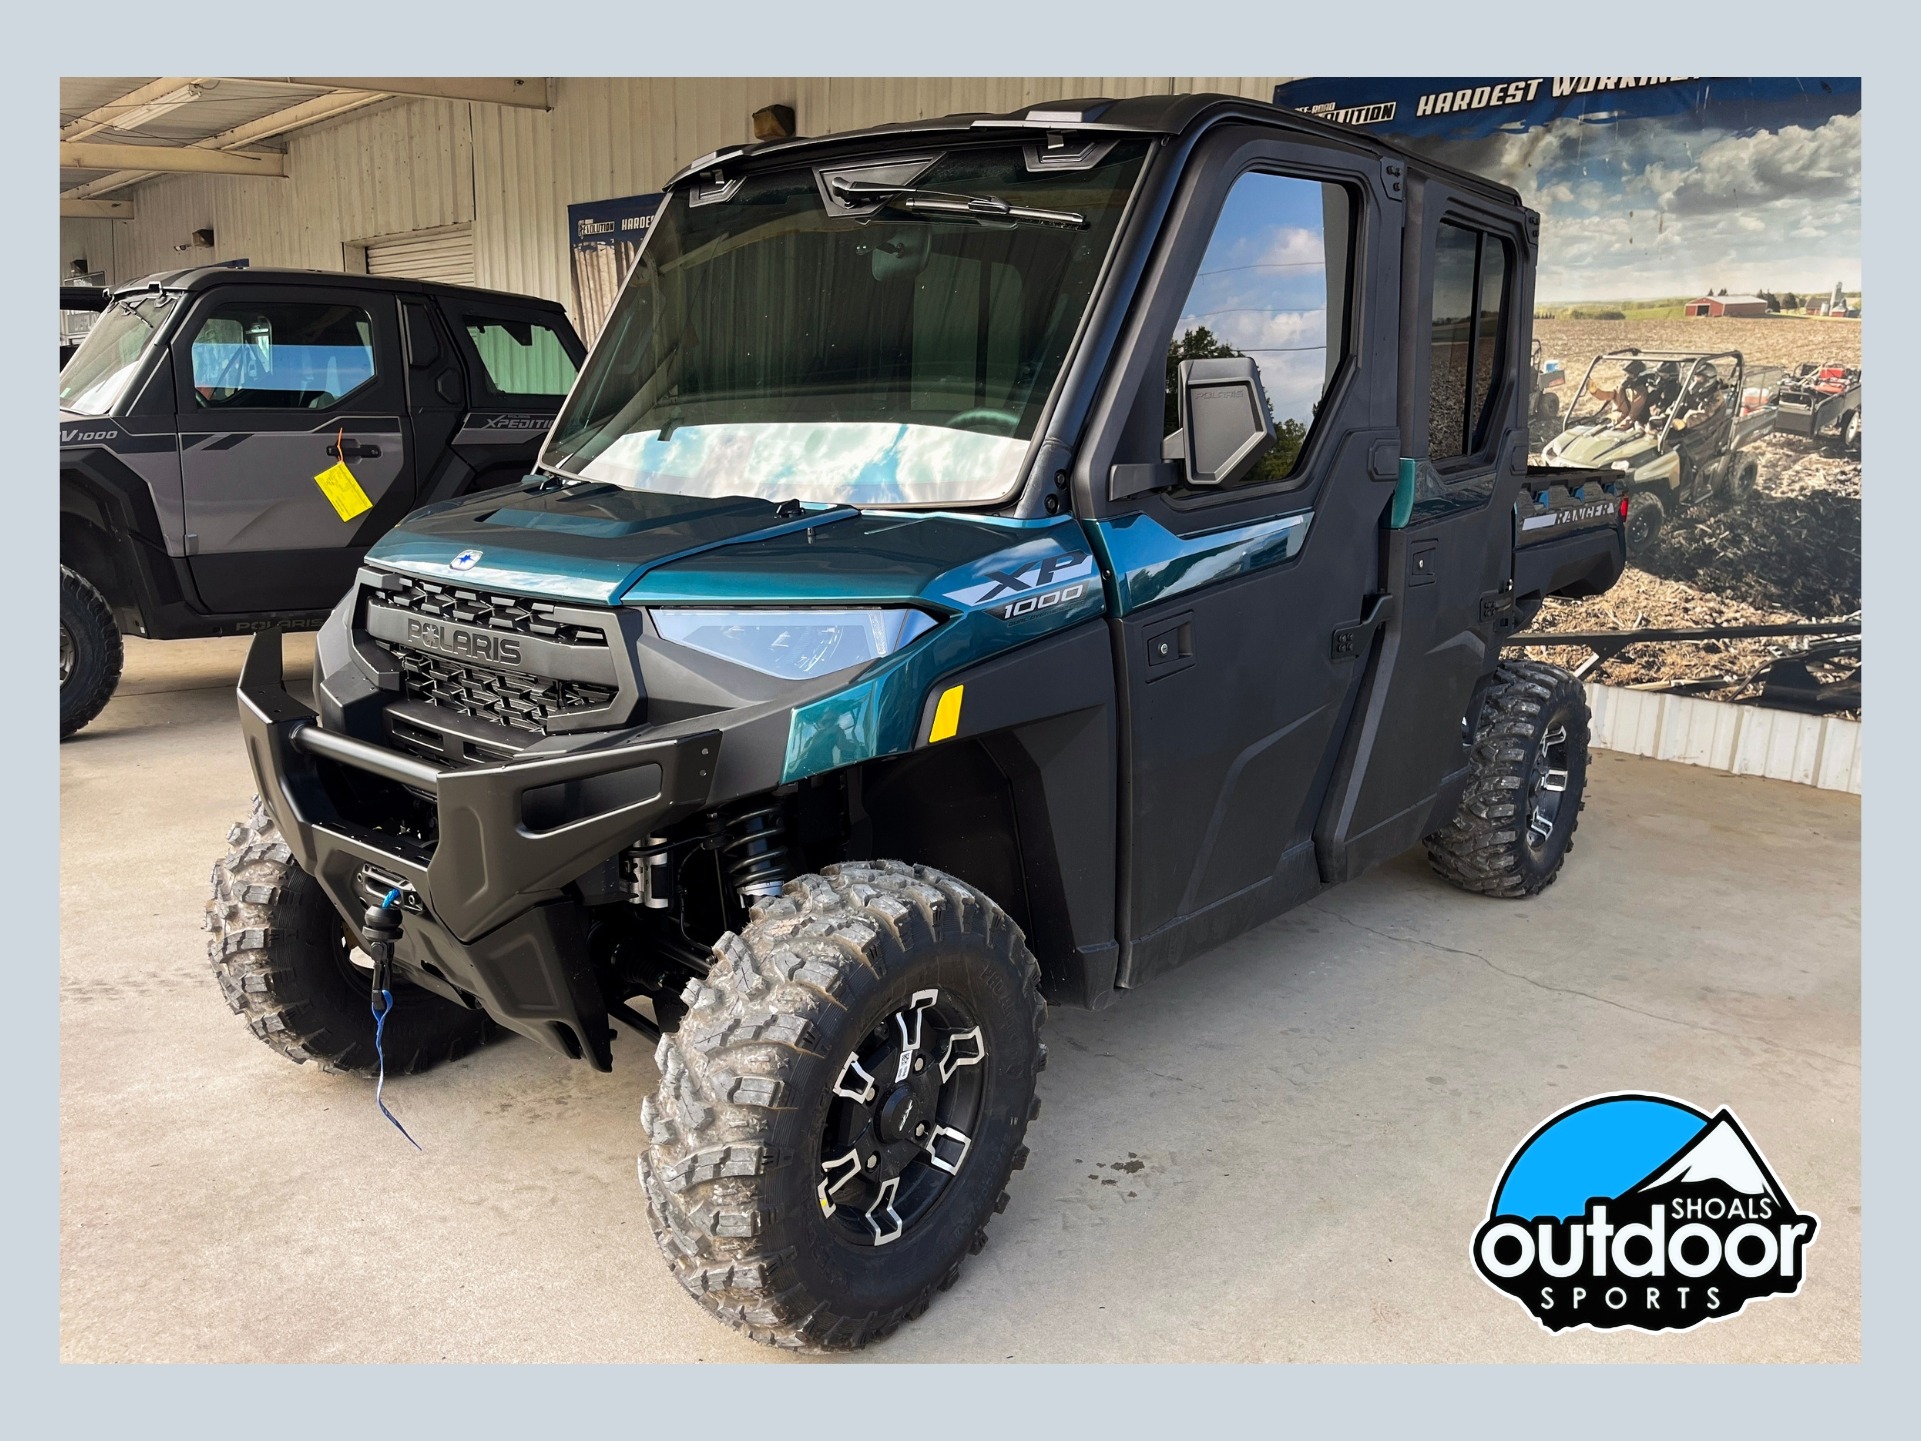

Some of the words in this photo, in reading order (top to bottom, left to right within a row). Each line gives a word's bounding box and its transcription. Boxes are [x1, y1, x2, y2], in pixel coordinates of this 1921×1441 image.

[1416, 78, 1543, 116] HARDEST
[1555, 504, 1613, 526] RANGER
[975, 549, 1090, 604] XP
[1004, 585, 1084, 620] 1000
[407, 617, 522, 667] POLARIS
